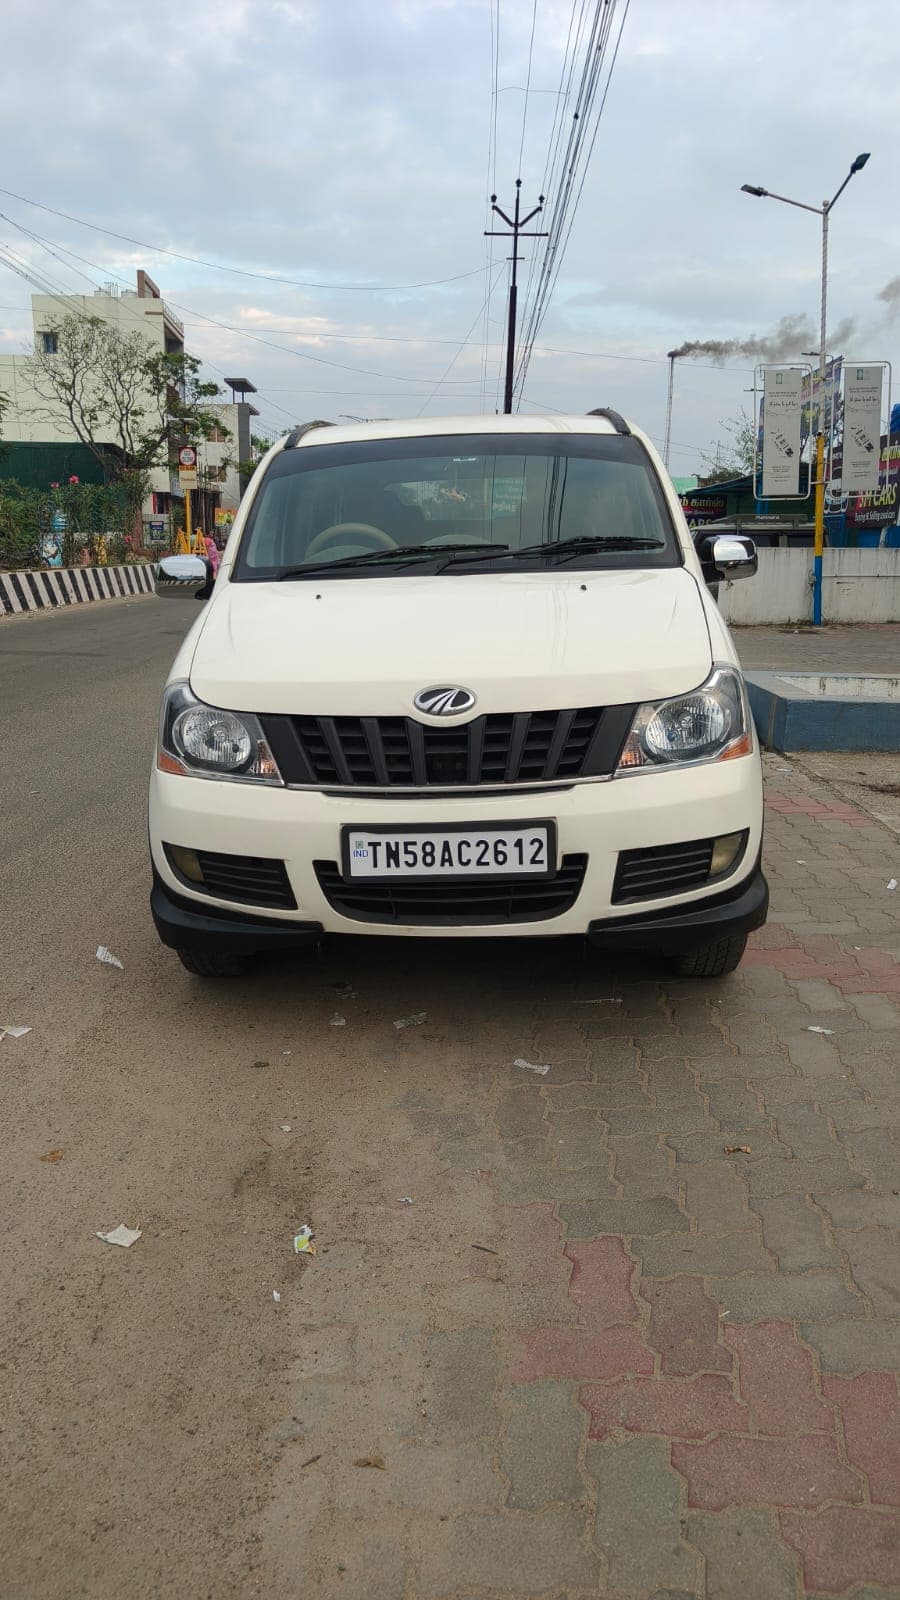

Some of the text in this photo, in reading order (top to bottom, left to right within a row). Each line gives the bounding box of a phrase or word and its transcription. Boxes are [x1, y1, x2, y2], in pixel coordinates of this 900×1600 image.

[873, 483, 897, 506] CARS
[353, 838, 545, 868] IND TN58AC2612
